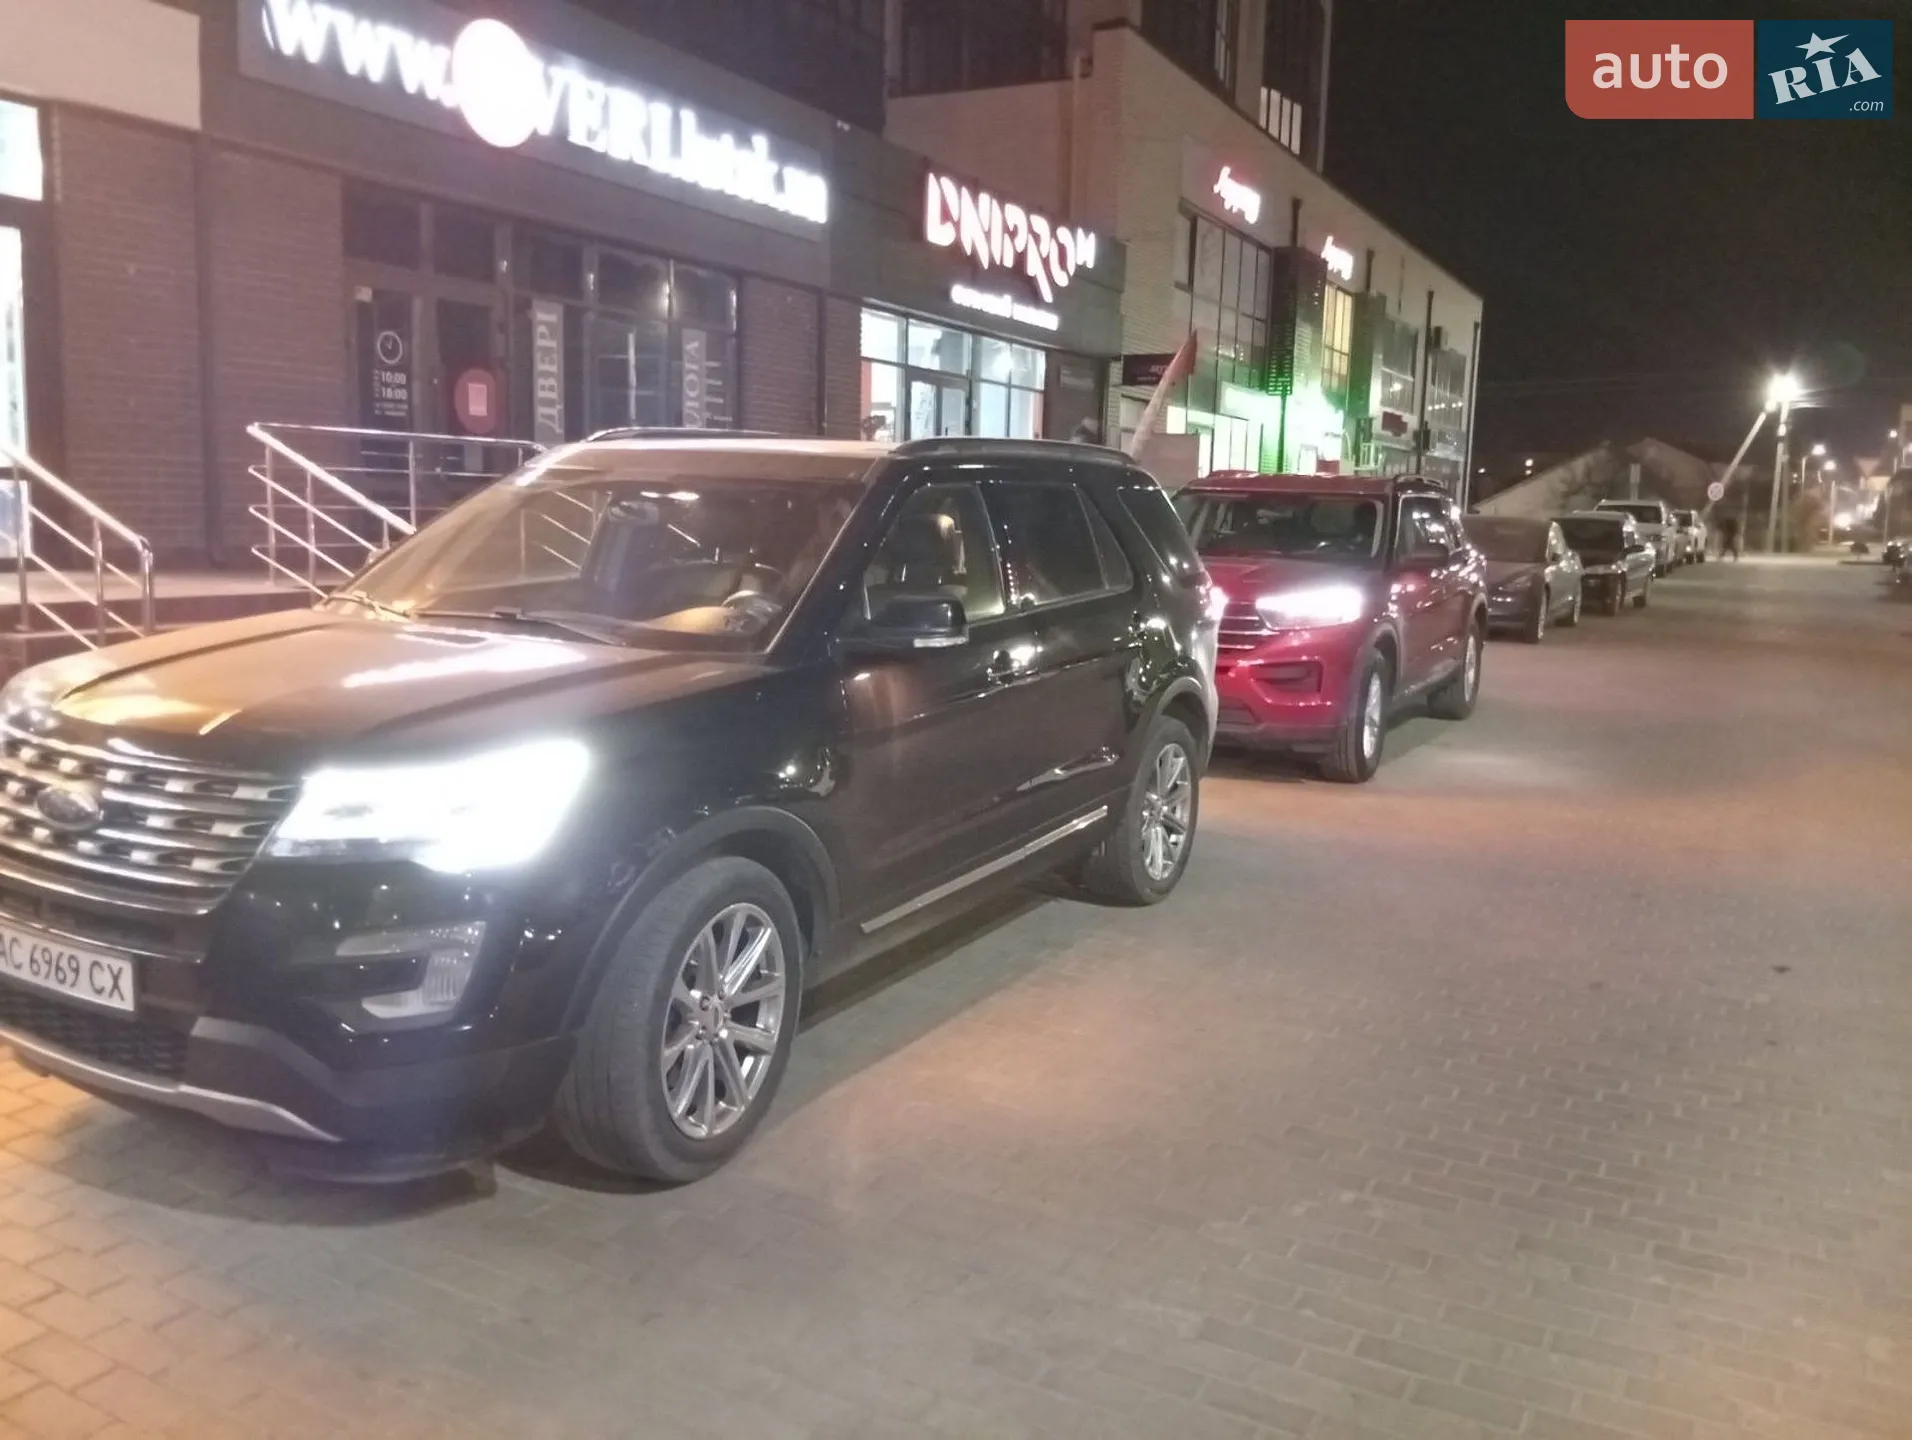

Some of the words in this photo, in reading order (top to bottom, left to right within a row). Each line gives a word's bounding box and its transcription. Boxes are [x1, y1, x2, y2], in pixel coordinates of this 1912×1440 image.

[536, 310, 564, 434] ДВЕРІ
[29, 943, 80, 989] 6969
[89, 959, 126, 1002] CX
